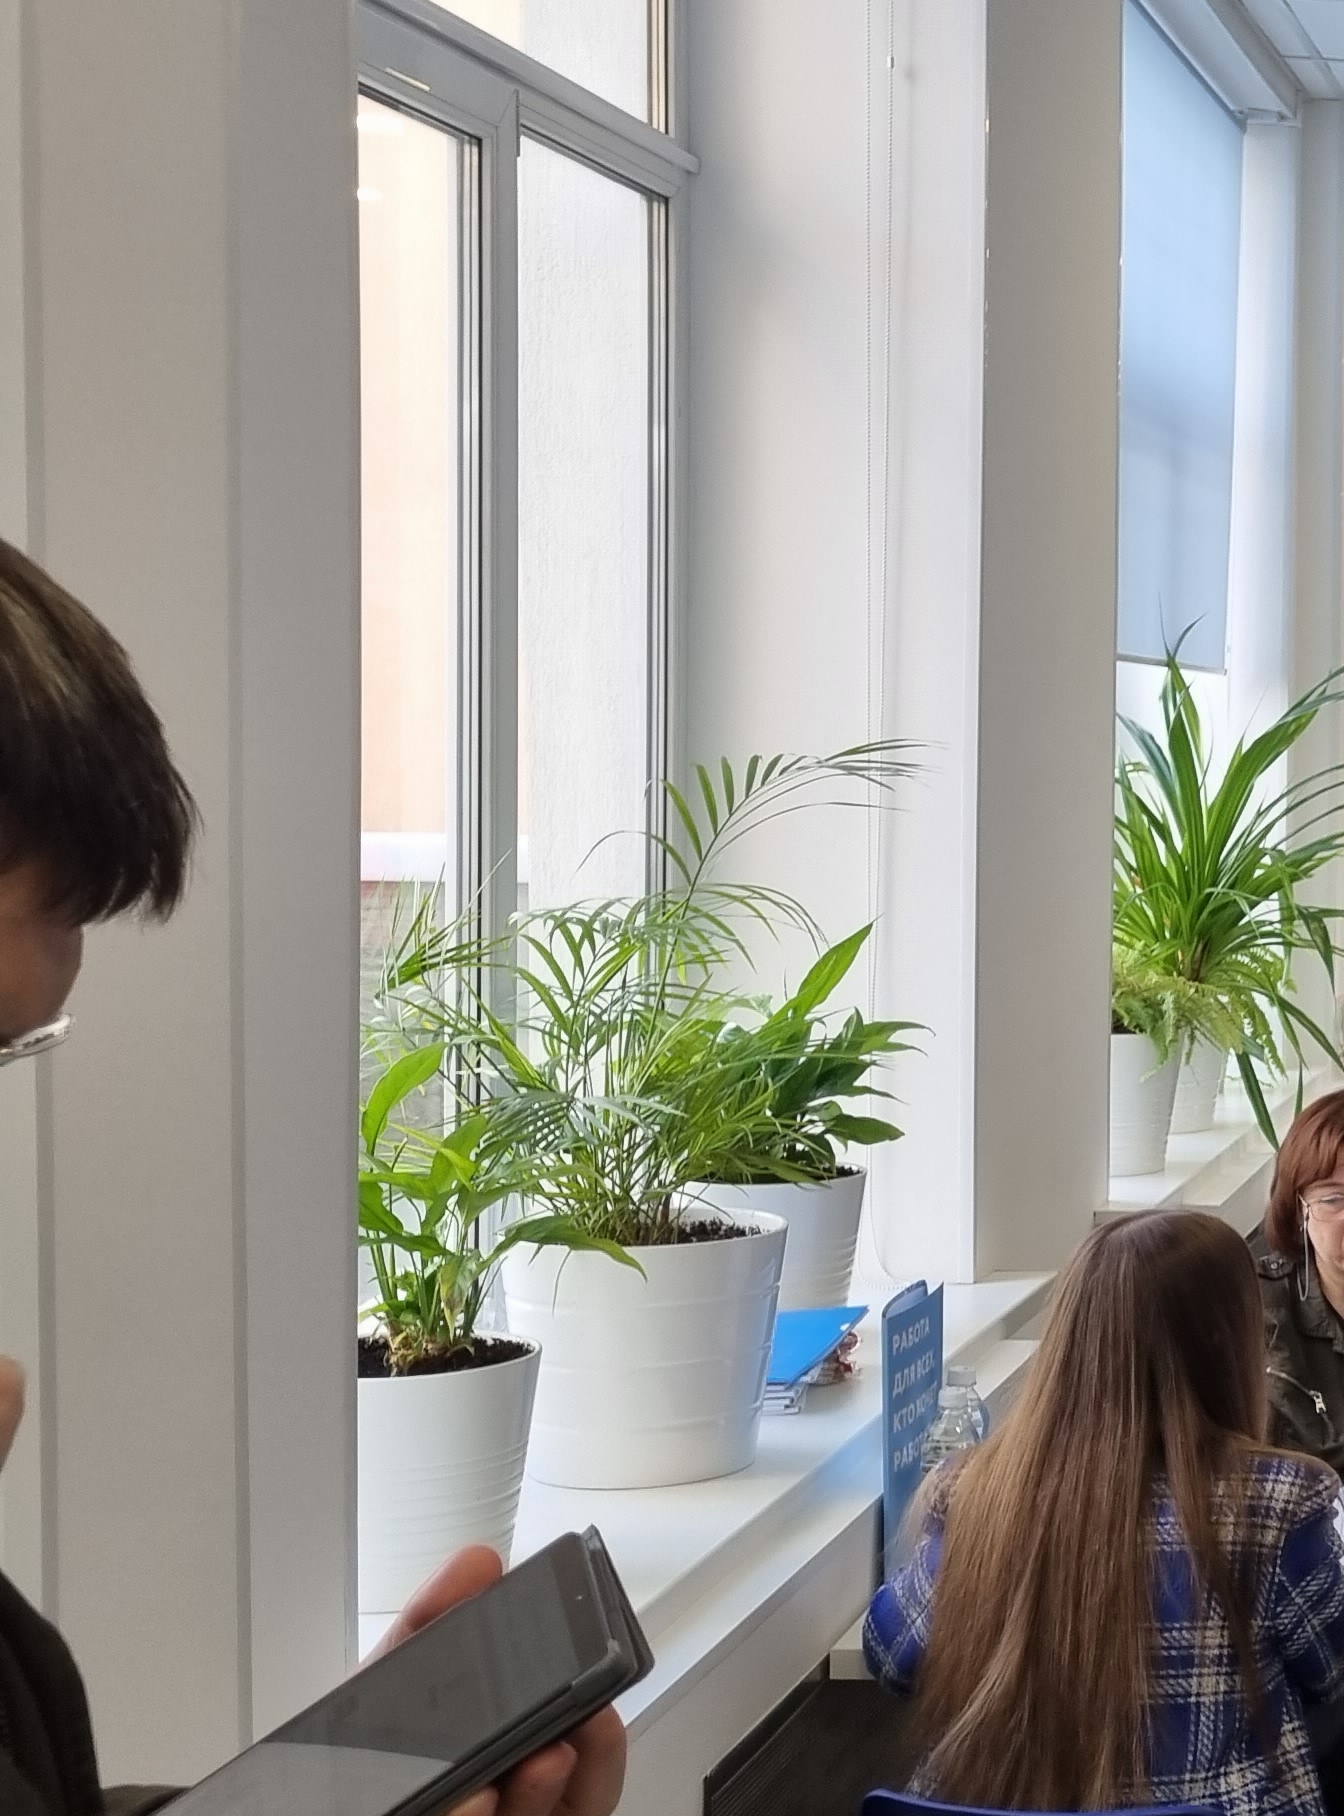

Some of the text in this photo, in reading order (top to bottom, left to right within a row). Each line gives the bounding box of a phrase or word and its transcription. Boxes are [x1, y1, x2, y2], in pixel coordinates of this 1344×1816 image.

[892, 1315, 931, 1356] РАБОТА
[892, 1365, 915, 1399] ДЛЯ
[893, 1404, 915, 1434] КТО
[893, 1424, 927, 1473] РАБОТ
